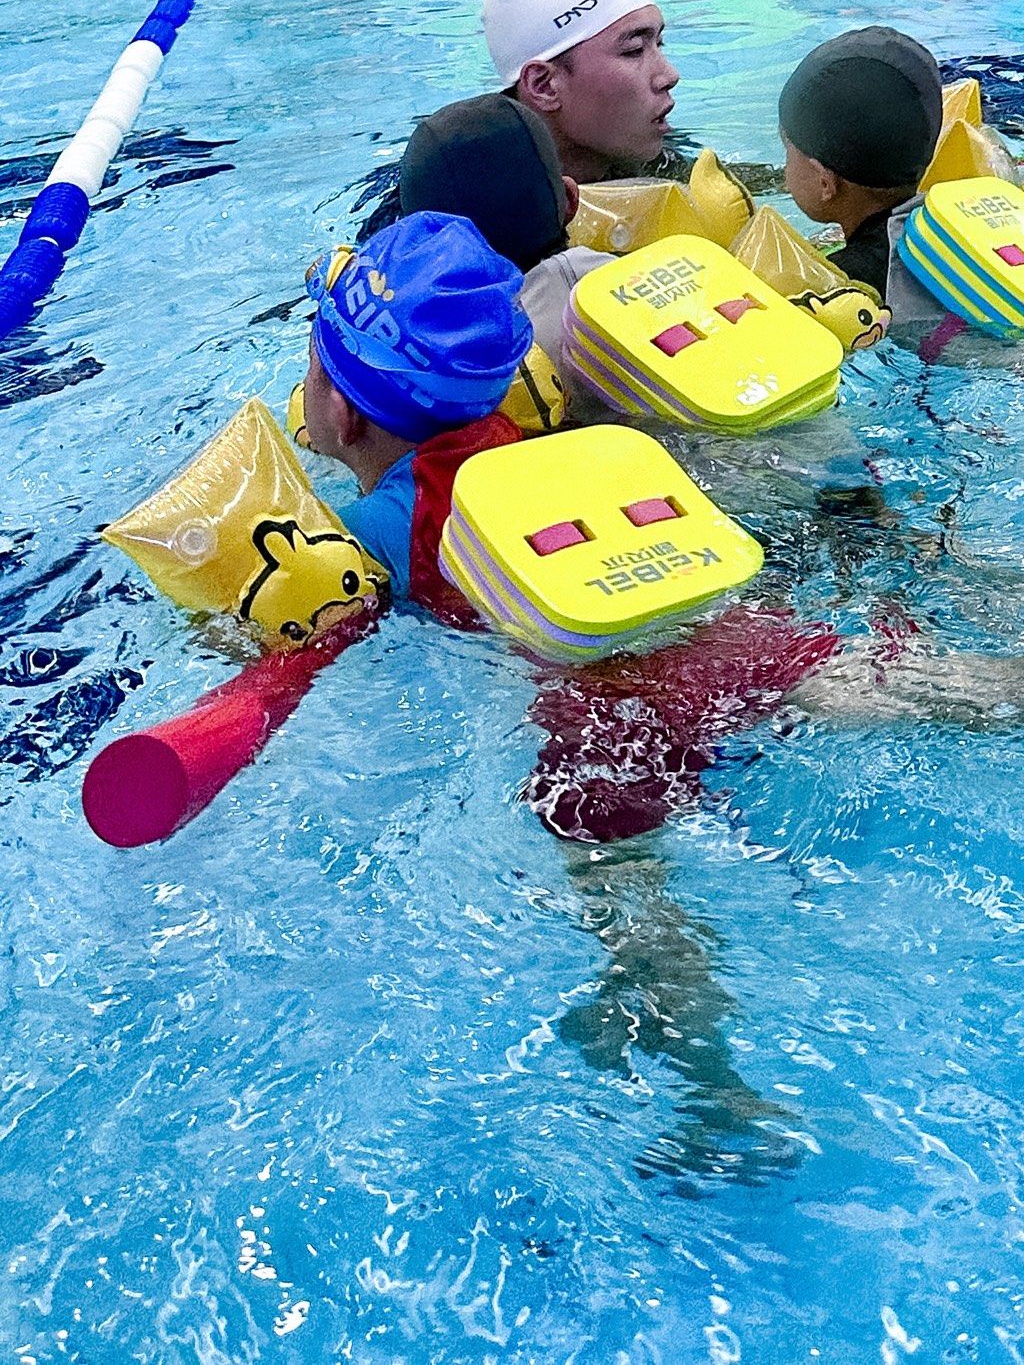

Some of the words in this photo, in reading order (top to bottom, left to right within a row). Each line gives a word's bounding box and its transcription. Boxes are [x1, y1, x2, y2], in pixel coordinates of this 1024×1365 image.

[609, 256, 706, 306] KEIBEL
[646, 279, 703, 310] 凯贝尔
[584, 547, 724, 596] KEIBEL
